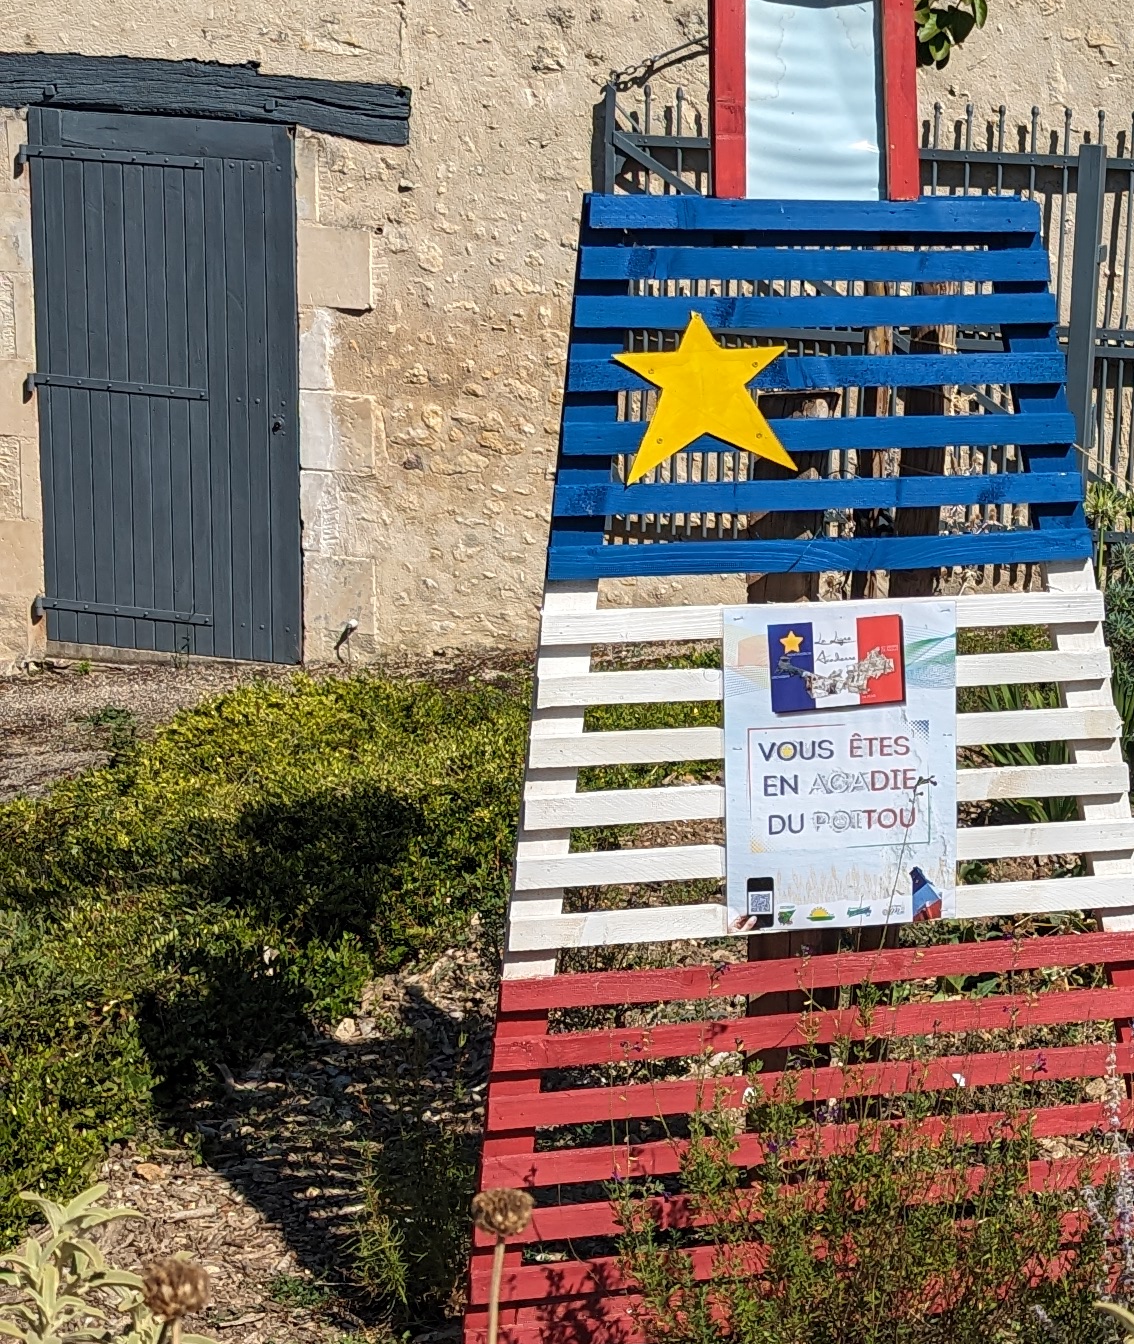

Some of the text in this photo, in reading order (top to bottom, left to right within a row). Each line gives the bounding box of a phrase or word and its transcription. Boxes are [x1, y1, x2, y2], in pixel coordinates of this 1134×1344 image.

[758, 732, 910, 762] VOUS ÊTES
[763, 769, 917, 797] EN ACADIE
[768, 807, 916, 835] DU POITOU
